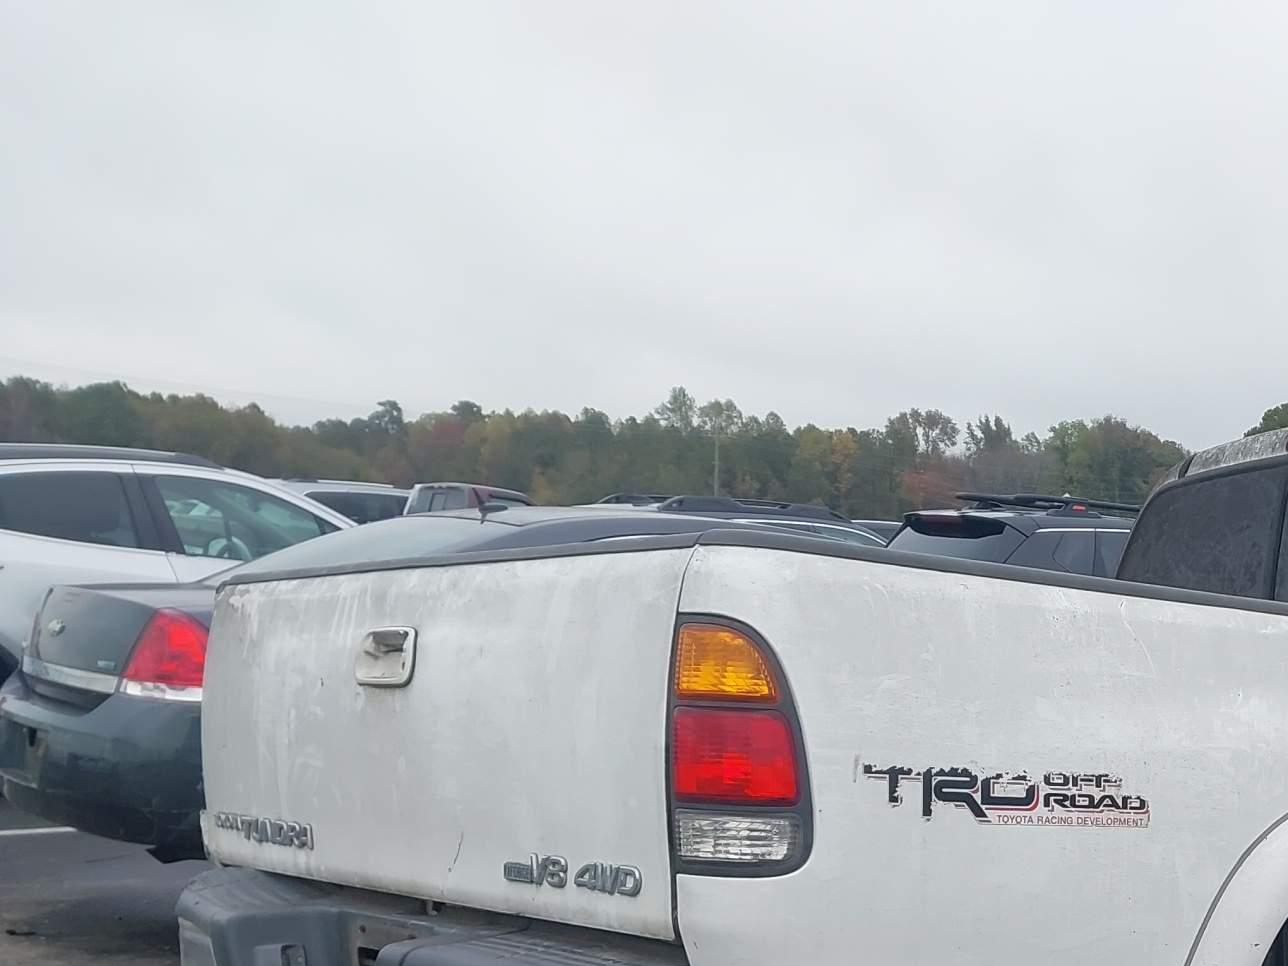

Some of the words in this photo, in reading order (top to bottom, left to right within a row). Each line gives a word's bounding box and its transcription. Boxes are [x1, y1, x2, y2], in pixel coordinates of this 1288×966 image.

[862, 764, 1037, 819] TRD
[1043, 793, 1146, 812] ROAD
[996, 814, 1034, 825] TOYOTA
[1037, 815, 1073, 825] RACING
[1076, 816, 1145, 827] DEVELOPMENT
[573, 861, 642, 897] 4WD
